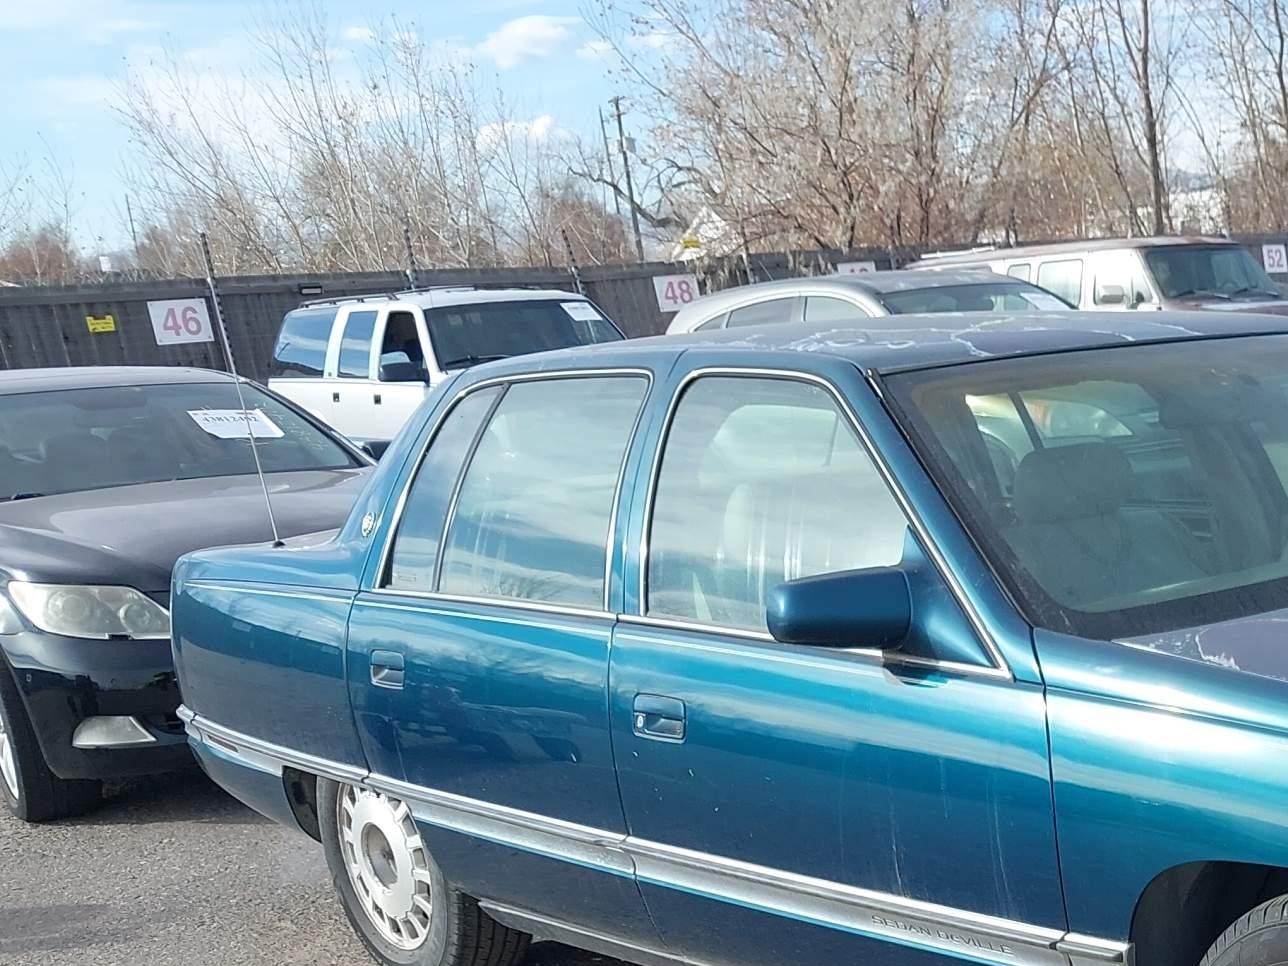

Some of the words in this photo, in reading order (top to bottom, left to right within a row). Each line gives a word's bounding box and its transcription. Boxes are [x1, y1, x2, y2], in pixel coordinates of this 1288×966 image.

[1267, 249, 1284, 268] 52
[665, 280, 694, 304] 48
[163, 306, 202, 337] 46
[871, 915, 931, 936] SEDAN
